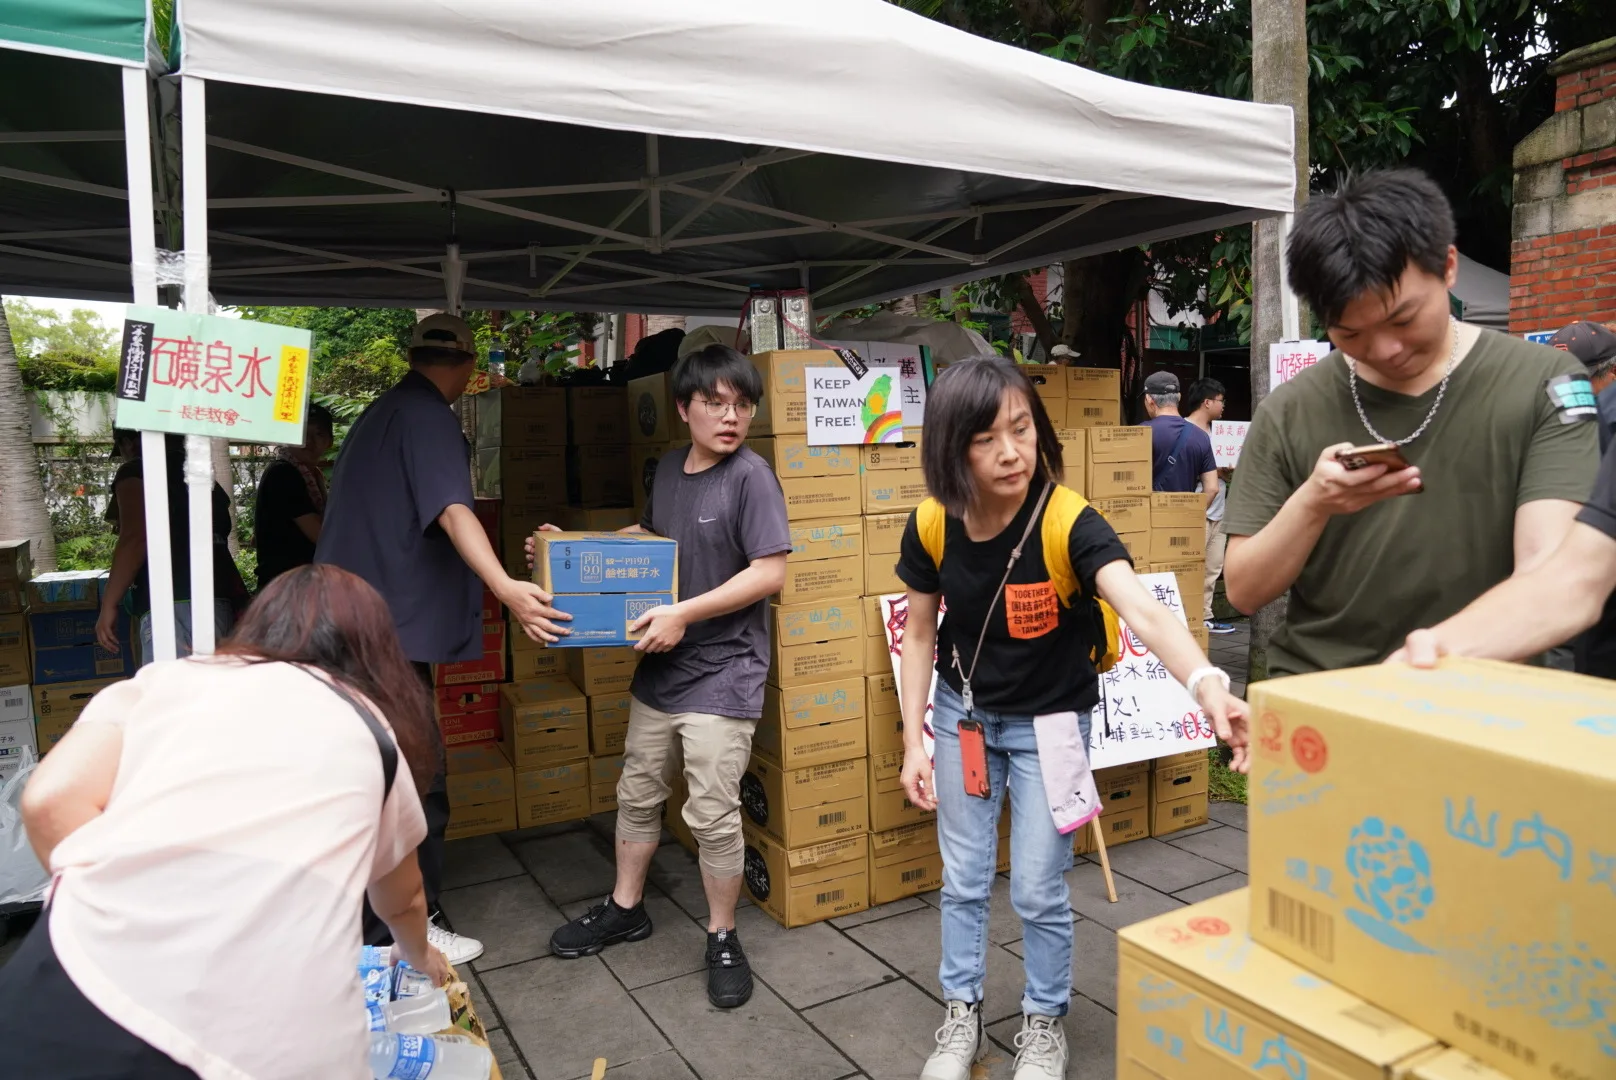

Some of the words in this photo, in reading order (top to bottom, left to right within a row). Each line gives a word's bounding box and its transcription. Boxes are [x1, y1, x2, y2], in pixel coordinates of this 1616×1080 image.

[151, 335, 273, 399] 礦泉水
[813, 378, 851, 390] KEEP
[814, 396, 867, 409] TAIWAN
[815, 415, 856, 427] FREE!
[565, 547, 571, 556] 5
[564, 560, 571, 569] 6
[584, 556, 599, 564] PH
